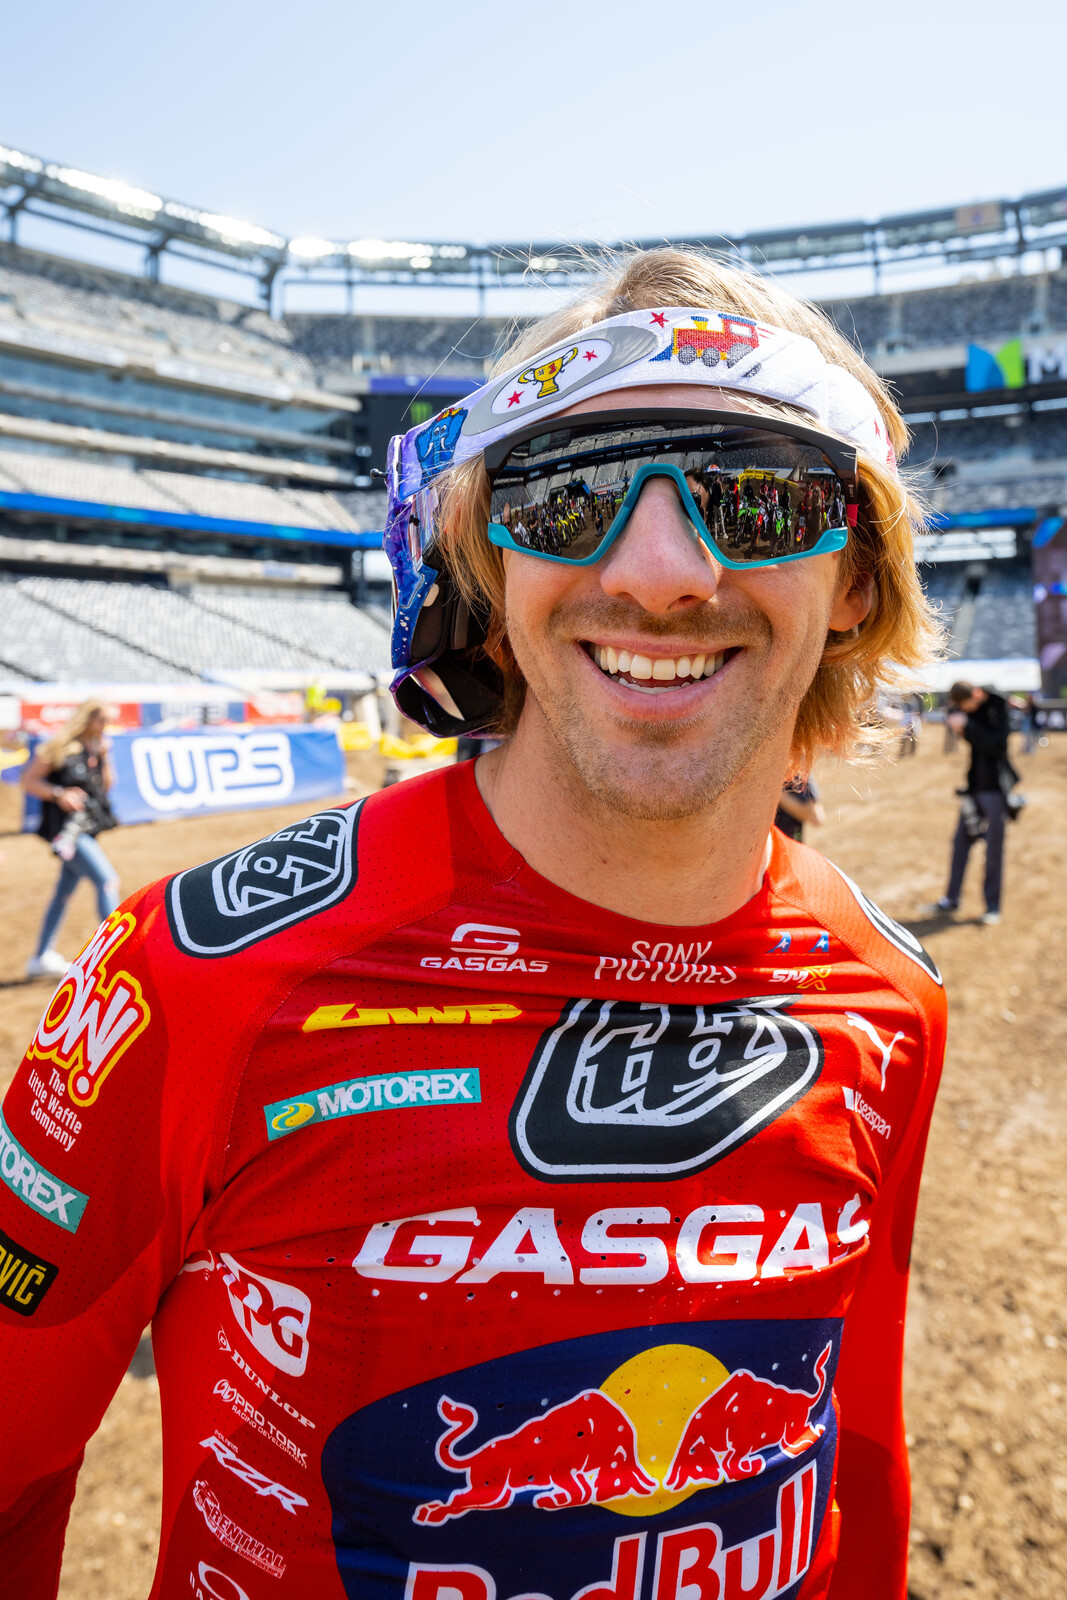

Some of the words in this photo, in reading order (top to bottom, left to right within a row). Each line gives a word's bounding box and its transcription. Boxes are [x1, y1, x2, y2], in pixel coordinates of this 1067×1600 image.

[131, 733, 295, 811] WPS
[420, 957, 549, 972] GASGAS
[631, 941, 713, 964] SONY
[768, 965, 832, 991] SMX
[48, 1067, 66, 1097] The
[317, 1072, 474, 1117] MOTOREX
[30, 1098, 76, 1152] Company
[48, 1094, 82, 1135] Waffle
[858, 1099, 892, 1140] seaspan
[231, 1350, 316, 1429] DUNLOP
[231, 1405, 257, 1428] RACING
[257, 1427, 307, 1469] DEVELOPMENT
[234, 1393, 265, 1426] PRO
[267, 1421, 308, 1464] TORK
[199, 1435, 310, 1515] RZR
[209, 1507, 286, 1569] RENTHAL
[655, 1459, 817, 1600] Bull
